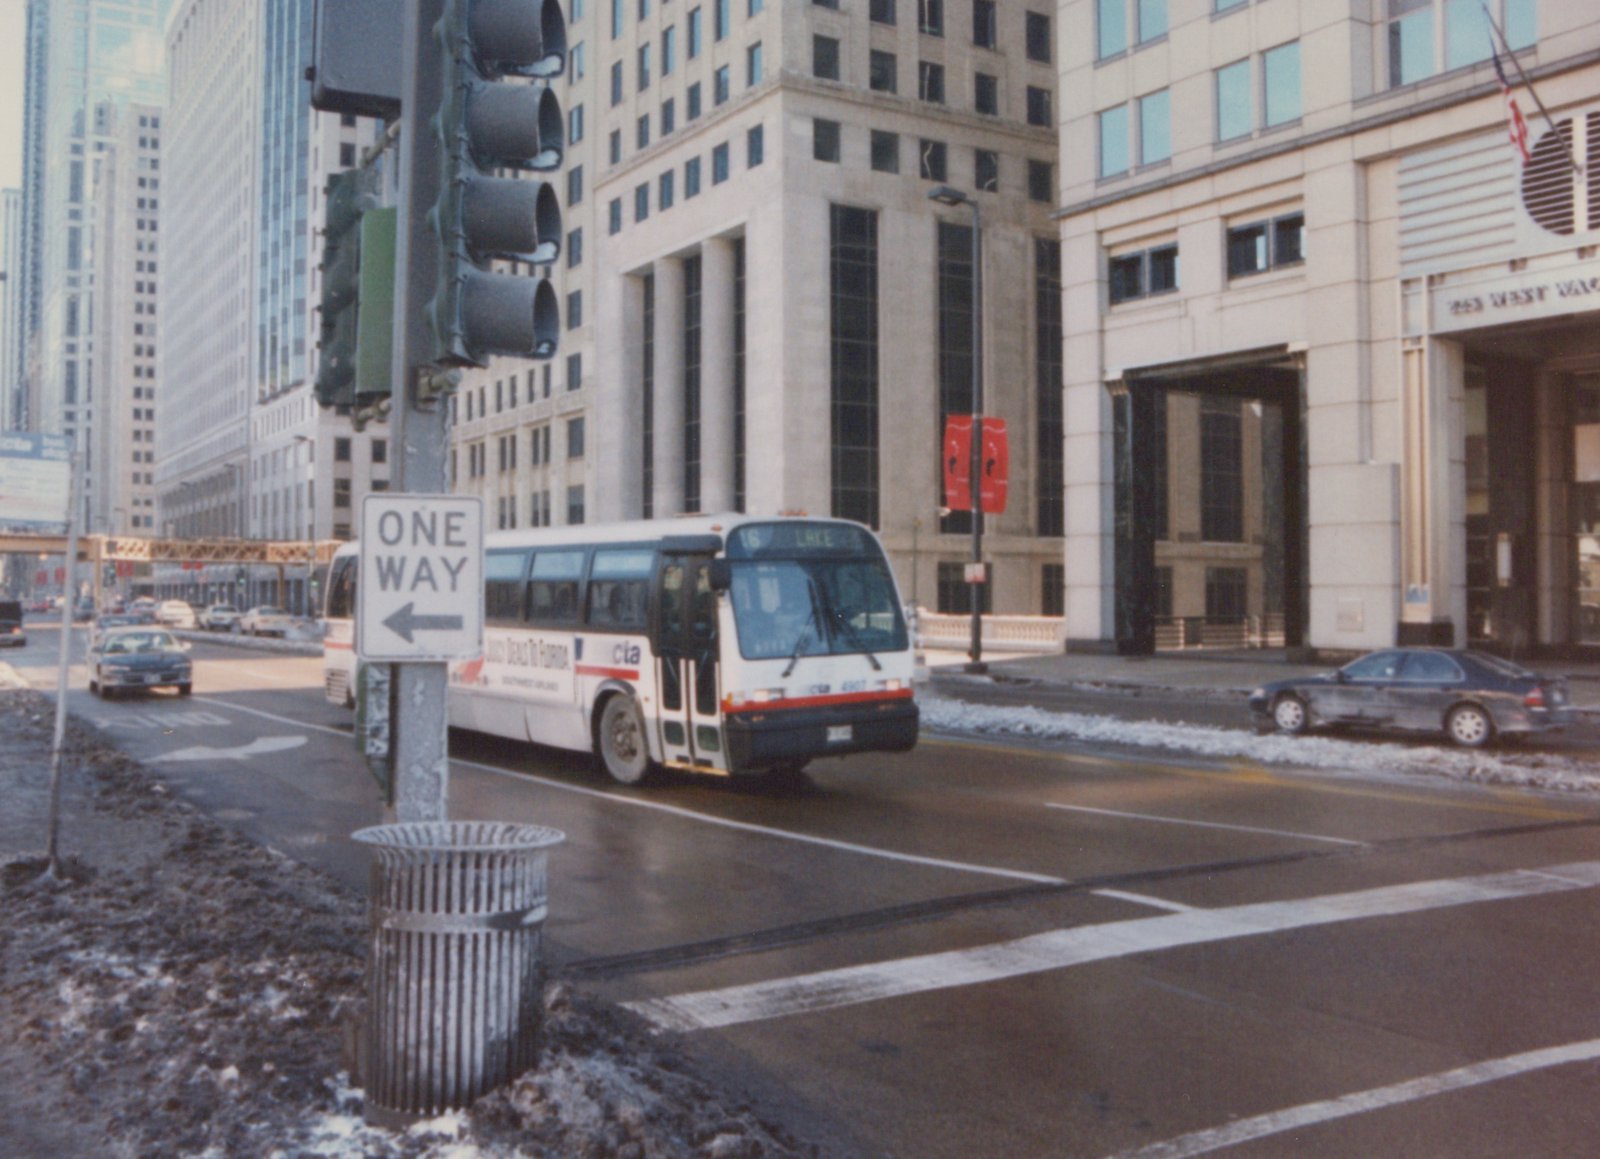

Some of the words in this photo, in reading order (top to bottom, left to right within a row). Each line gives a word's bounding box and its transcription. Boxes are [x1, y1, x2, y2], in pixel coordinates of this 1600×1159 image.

[1490, 285, 1548, 308] WEST
[378, 510, 467, 547] ONE
[375, 555, 468, 592] WAY
[612, 640, 641, 665] cta
